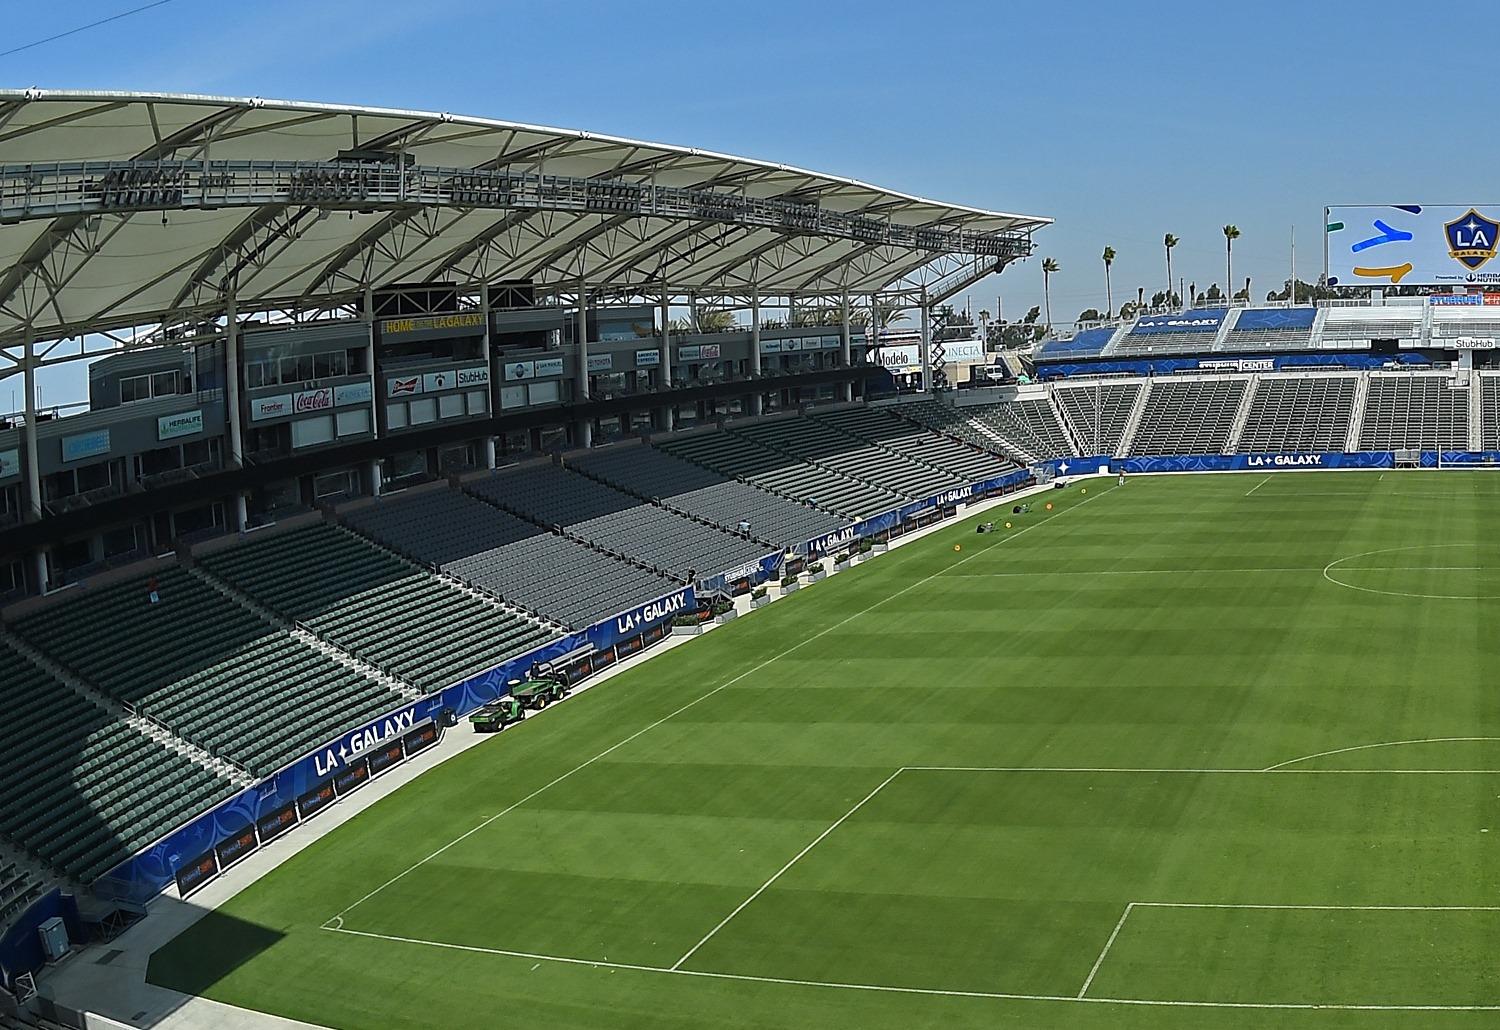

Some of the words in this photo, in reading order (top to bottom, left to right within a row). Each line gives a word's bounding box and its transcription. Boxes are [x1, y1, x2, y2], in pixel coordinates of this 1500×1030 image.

[1456, 230, 1490, 247] LA
[386, 320, 414, 333] HOME
[1455, 339, 1493, 348] StubHub
[944, 346, 980, 356] INECTA
[1242, 361, 1274, 370] CENTER
[458, 371, 488, 383] StubHub
[169, 415, 201, 427] HERBALIFE
[1248, 456, 1264, 466] LA
[936, 496, 945, 505] LA
[948, 486, 973, 501] GALAXY
[617, 614, 635, 634] LA
[314, 749, 339, 777] LA
[350, 707, 415, 755] GALAXY
